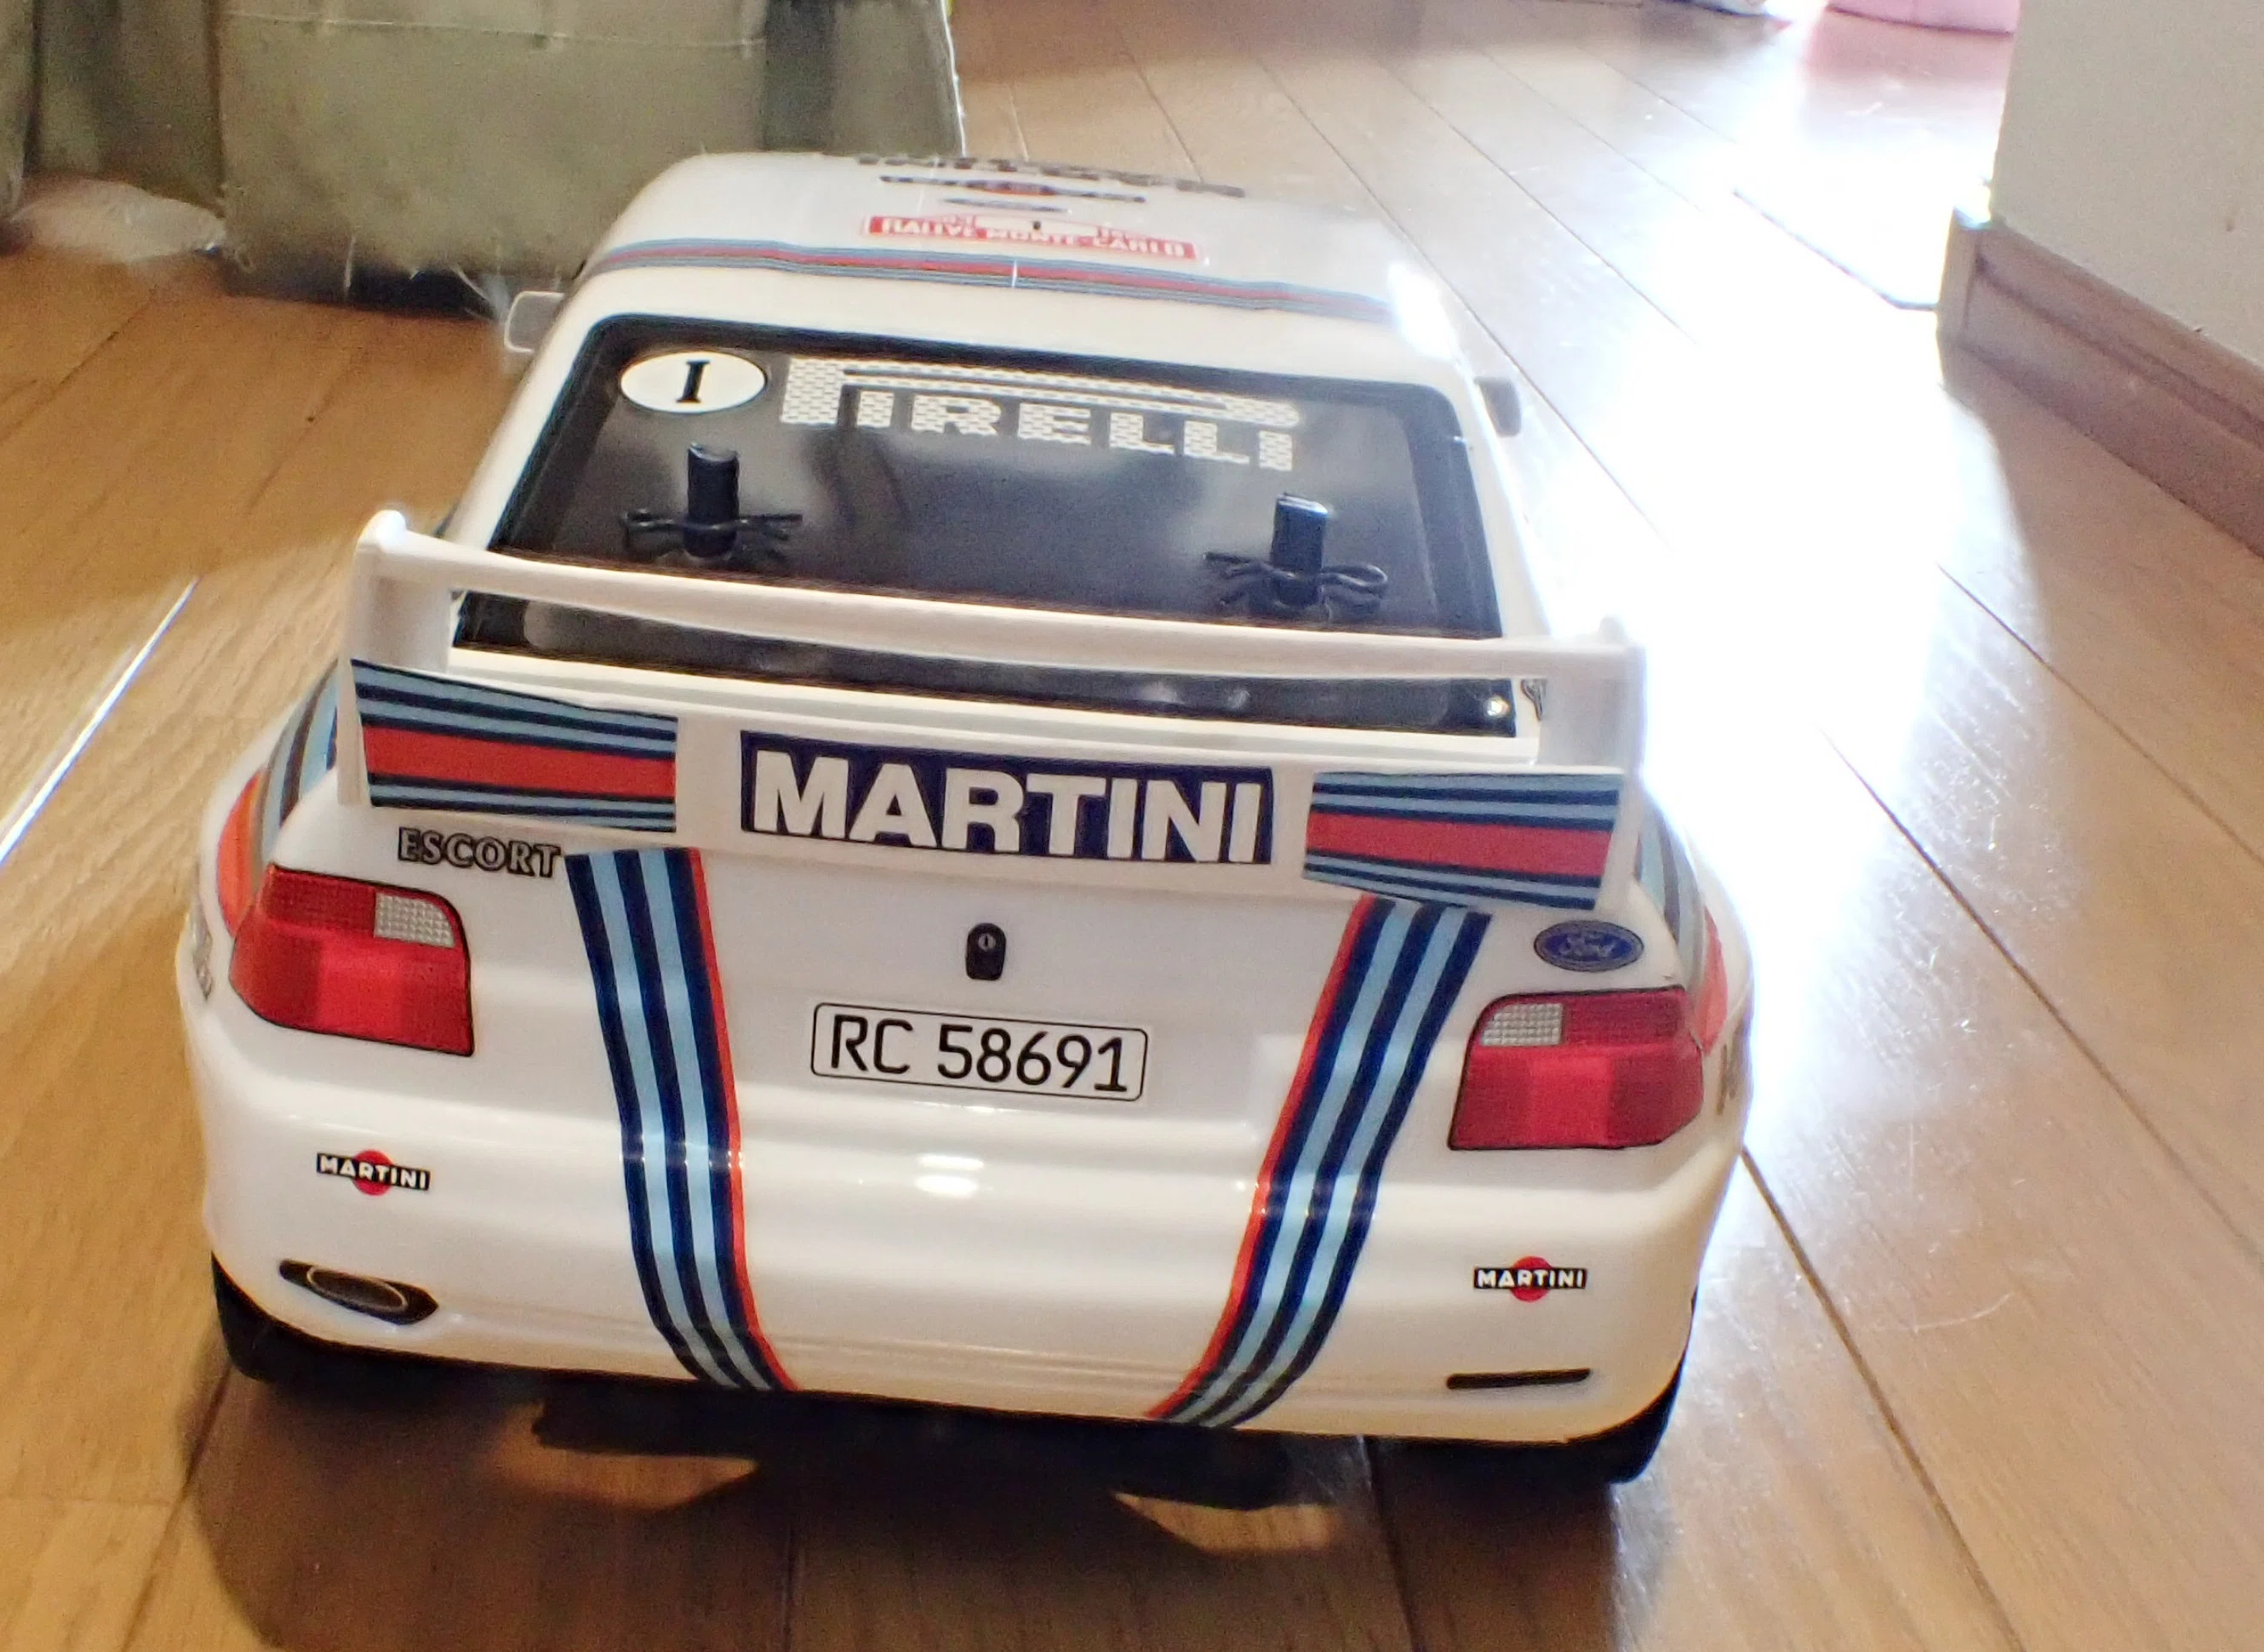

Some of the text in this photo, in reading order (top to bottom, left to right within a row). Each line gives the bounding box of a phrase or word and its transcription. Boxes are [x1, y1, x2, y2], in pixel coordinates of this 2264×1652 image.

[780, 357, 1301, 472] PIRELLI
[752, 749, 1262, 862] MARTINI
[397, 826, 562, 878] ESCORT
[831, 1013, 1129, 1093] RC 58691
[319, 1154, 426, 1190] MARTINI
[1477, 1268, 1584, 1288] MARTINI
